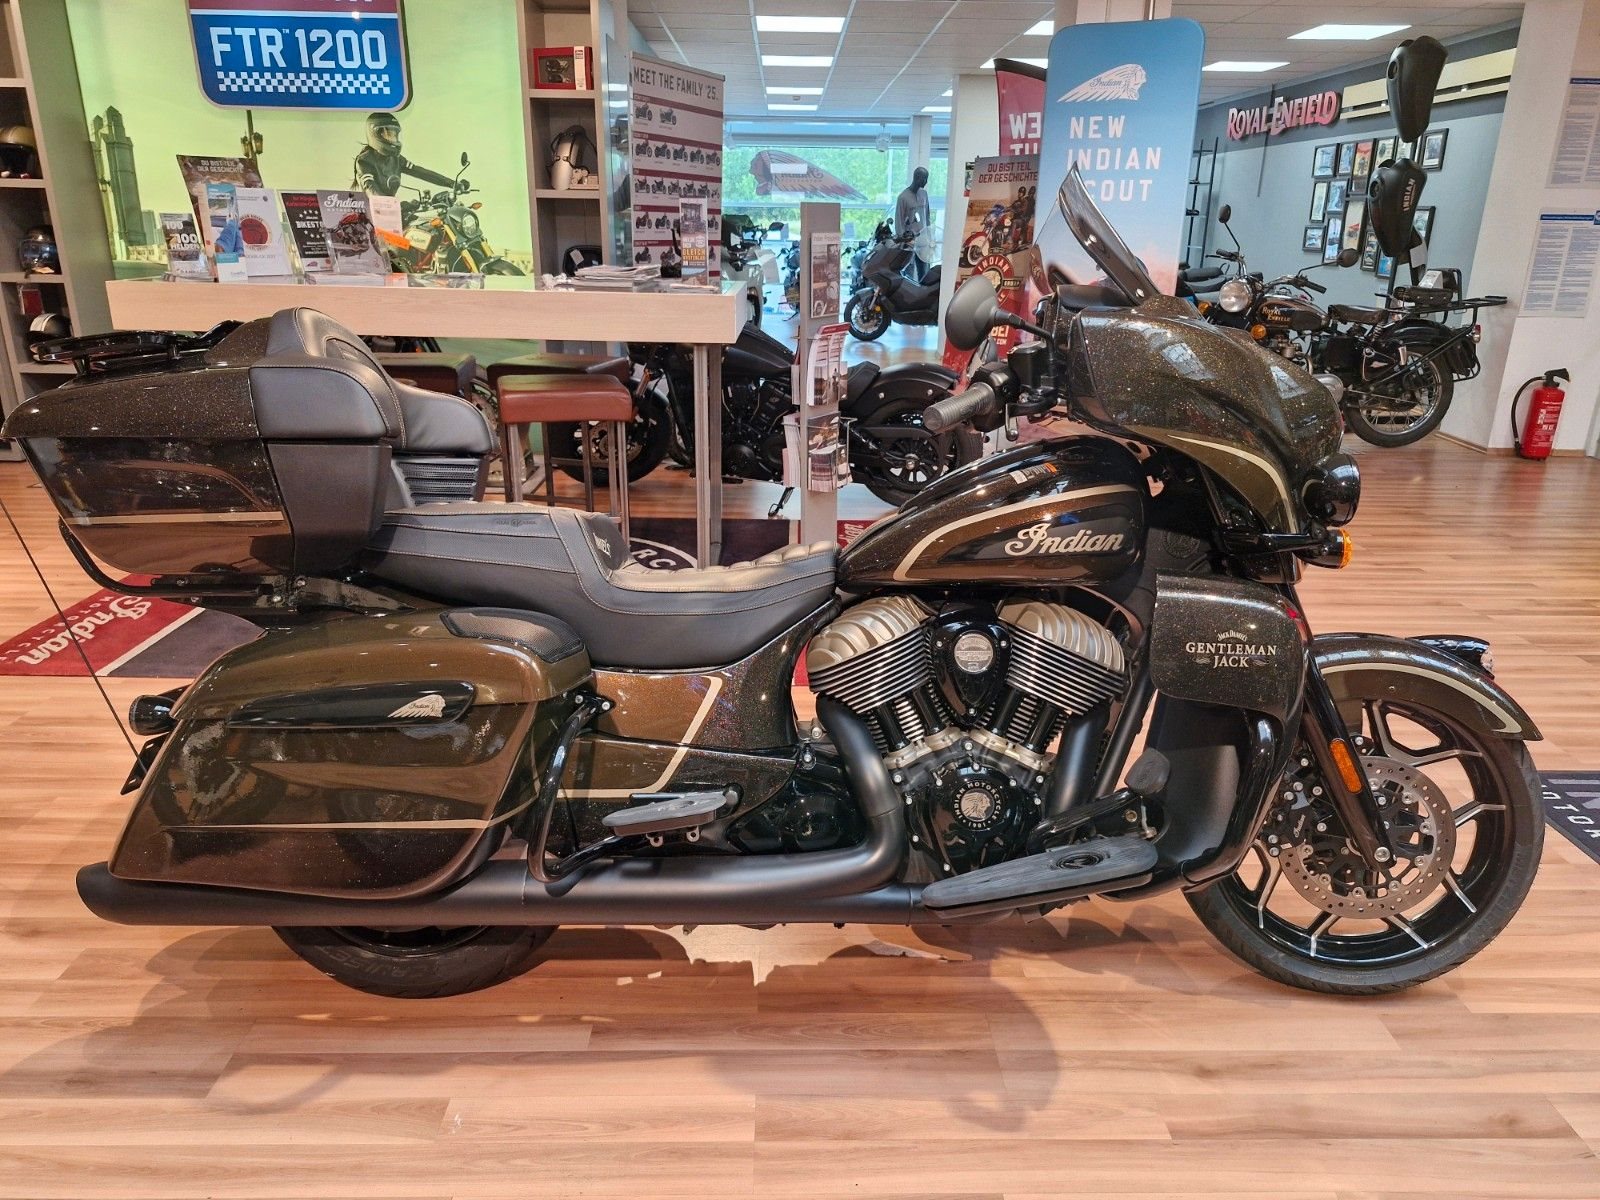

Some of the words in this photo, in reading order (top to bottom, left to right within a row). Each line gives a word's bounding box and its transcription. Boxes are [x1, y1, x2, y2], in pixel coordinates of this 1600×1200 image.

[294, 28, 388, 70] 1200
[633, 66, 657, 86] MEET
[658, 72, 674, 91] THE
[676, 77, 704, 97] FAMILY
[1088, 77, 1123, 88] Indian
[1226, 105, 1268, 141] ROYAL
[1268, 90, 1338, 136] ENFIELD
[1069, 115, 1126, 139] NEW
[987, 163, 998, 173] DU
[998, 161, 1015, 172] BIST
[1015, 160, 1032, 171] TEIL
[1066, 146, 1162, 171] INDIAN
[978, 174, 993, 183] DER
[994, 171, 1038, 182] GESCHICHTE
[324, 193, 365, 208] Indian
[1402, 178, 1416, 212] INDIAN
[165, 220, 184, 230] 100
[977, 256, 1010, 273] INDIAN
[1005, 522, 1124, 556] Indian
[1185, 642, 1277, 656] GENTLEMAN
[1213, 655, 1250, 669] JACK
[953, 787, 966, 819] INDIAN
[967, 781, 1002, 820] MOTORCYCLE
